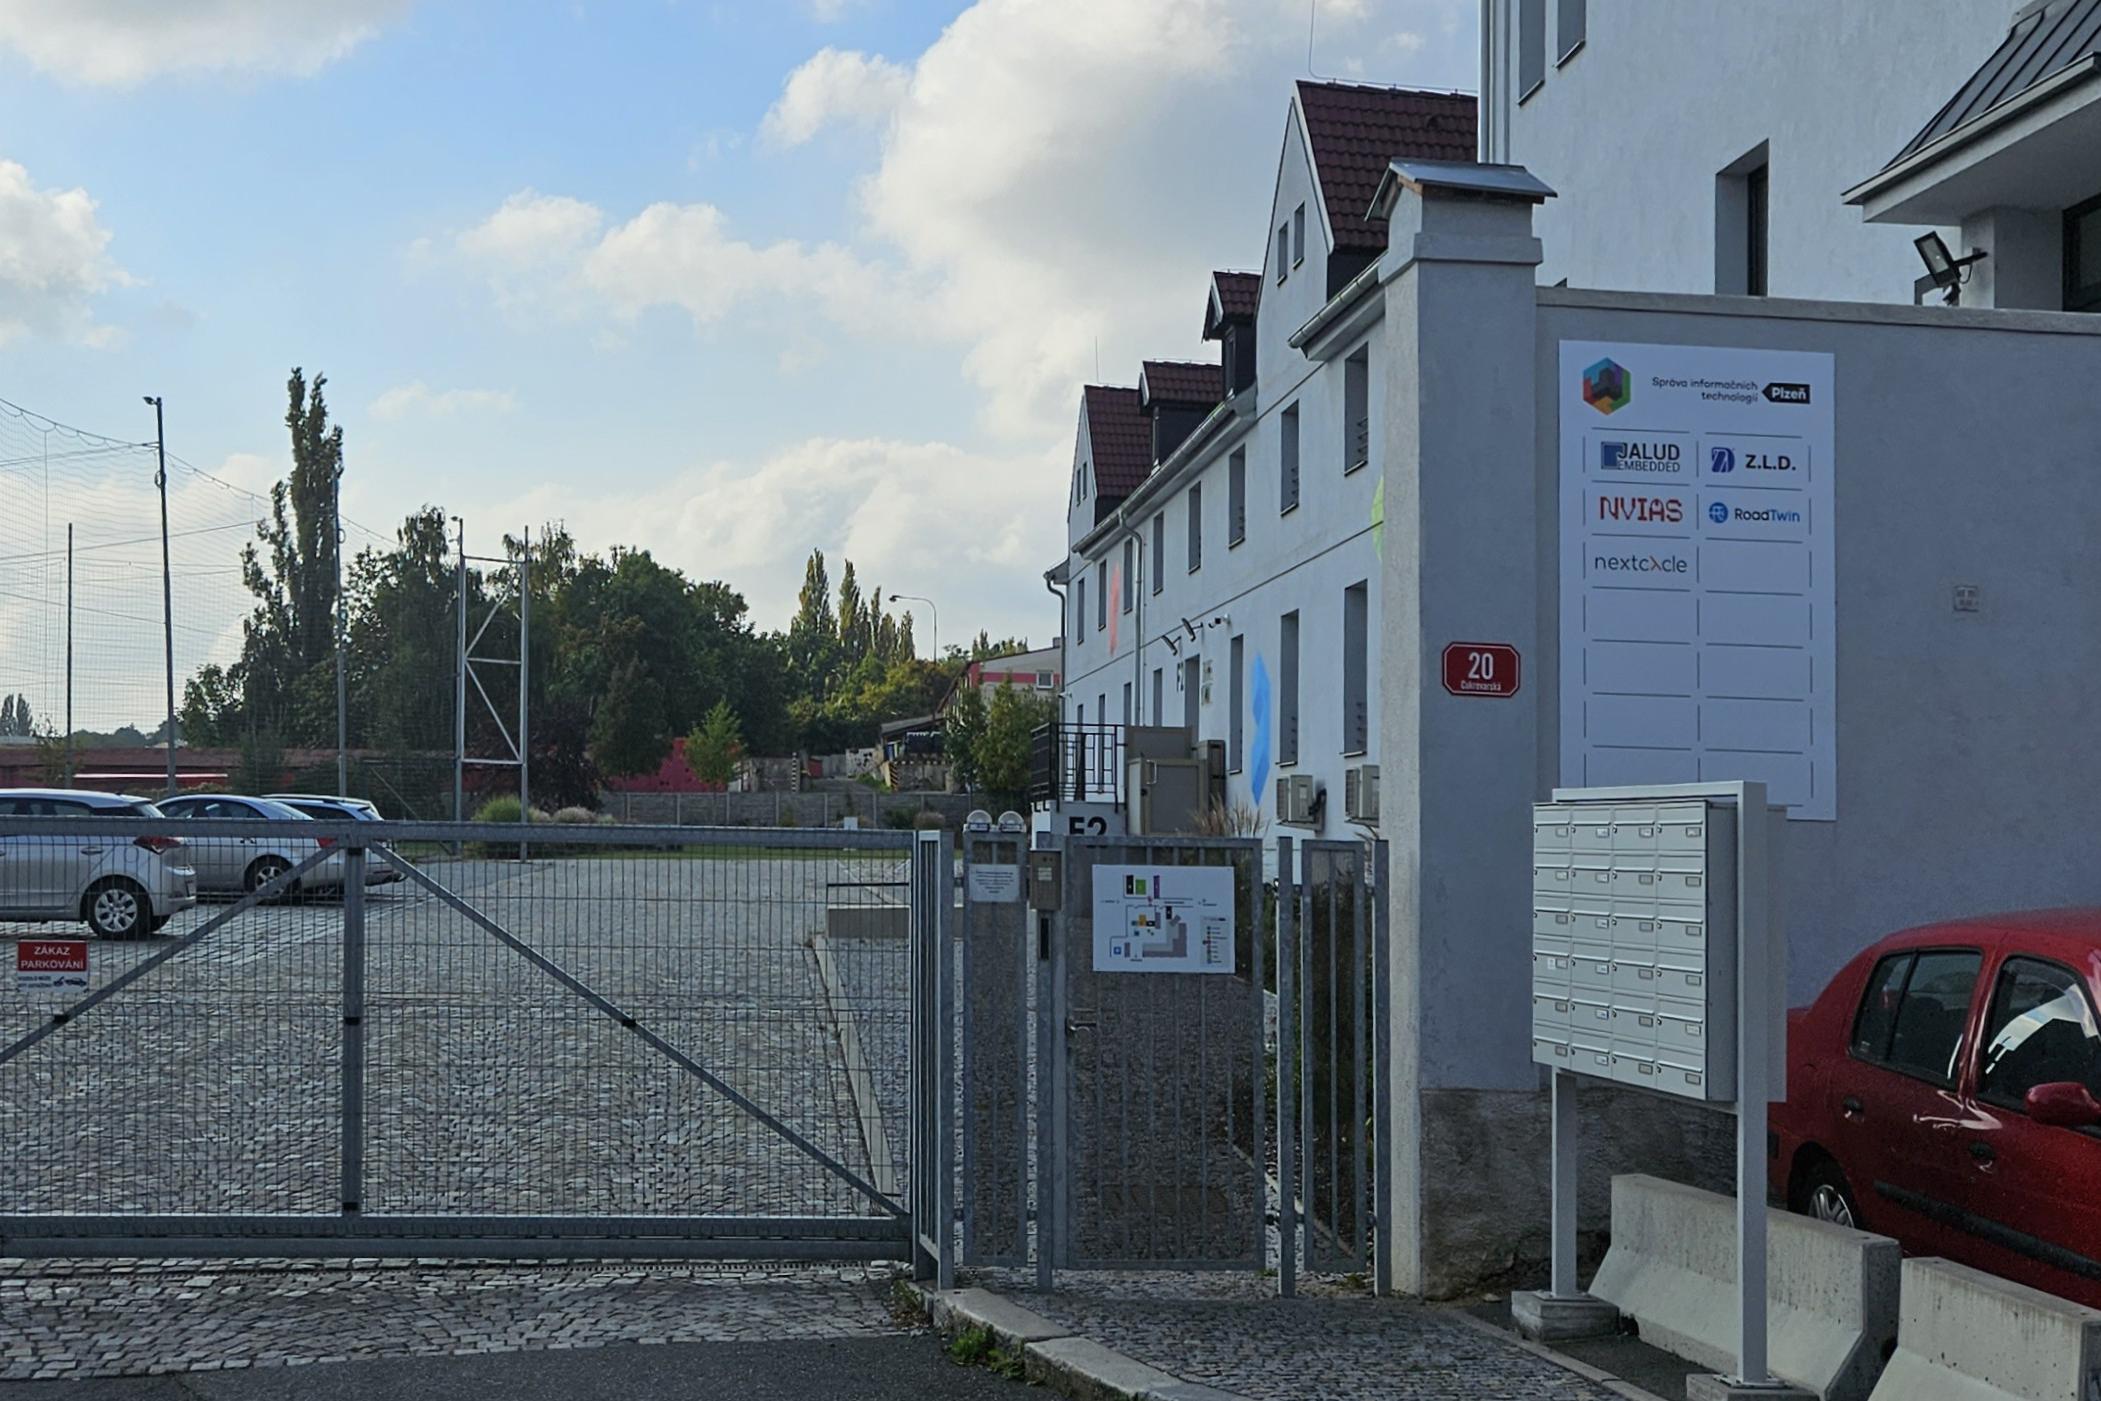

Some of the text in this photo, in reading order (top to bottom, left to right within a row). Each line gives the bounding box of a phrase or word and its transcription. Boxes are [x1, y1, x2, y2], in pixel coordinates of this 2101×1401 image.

[1771, 386, 1807, 400] Plzeň
[1617, 442, 1680, 461] JALUD
[1617, 460, 1680, 473] EMBEDDED
[1745, 454, 1796, 471] Z.L.D.
[1600, 496, 1683, 522] NVIAS
[1734, 508, 1800, 522] RoadTwin
[1468, 652, 1493, 680] 20
[34, 944, 70, 955] ZÁKAZ
[20, 959, 84, 969] PARKOVÁNÍ
